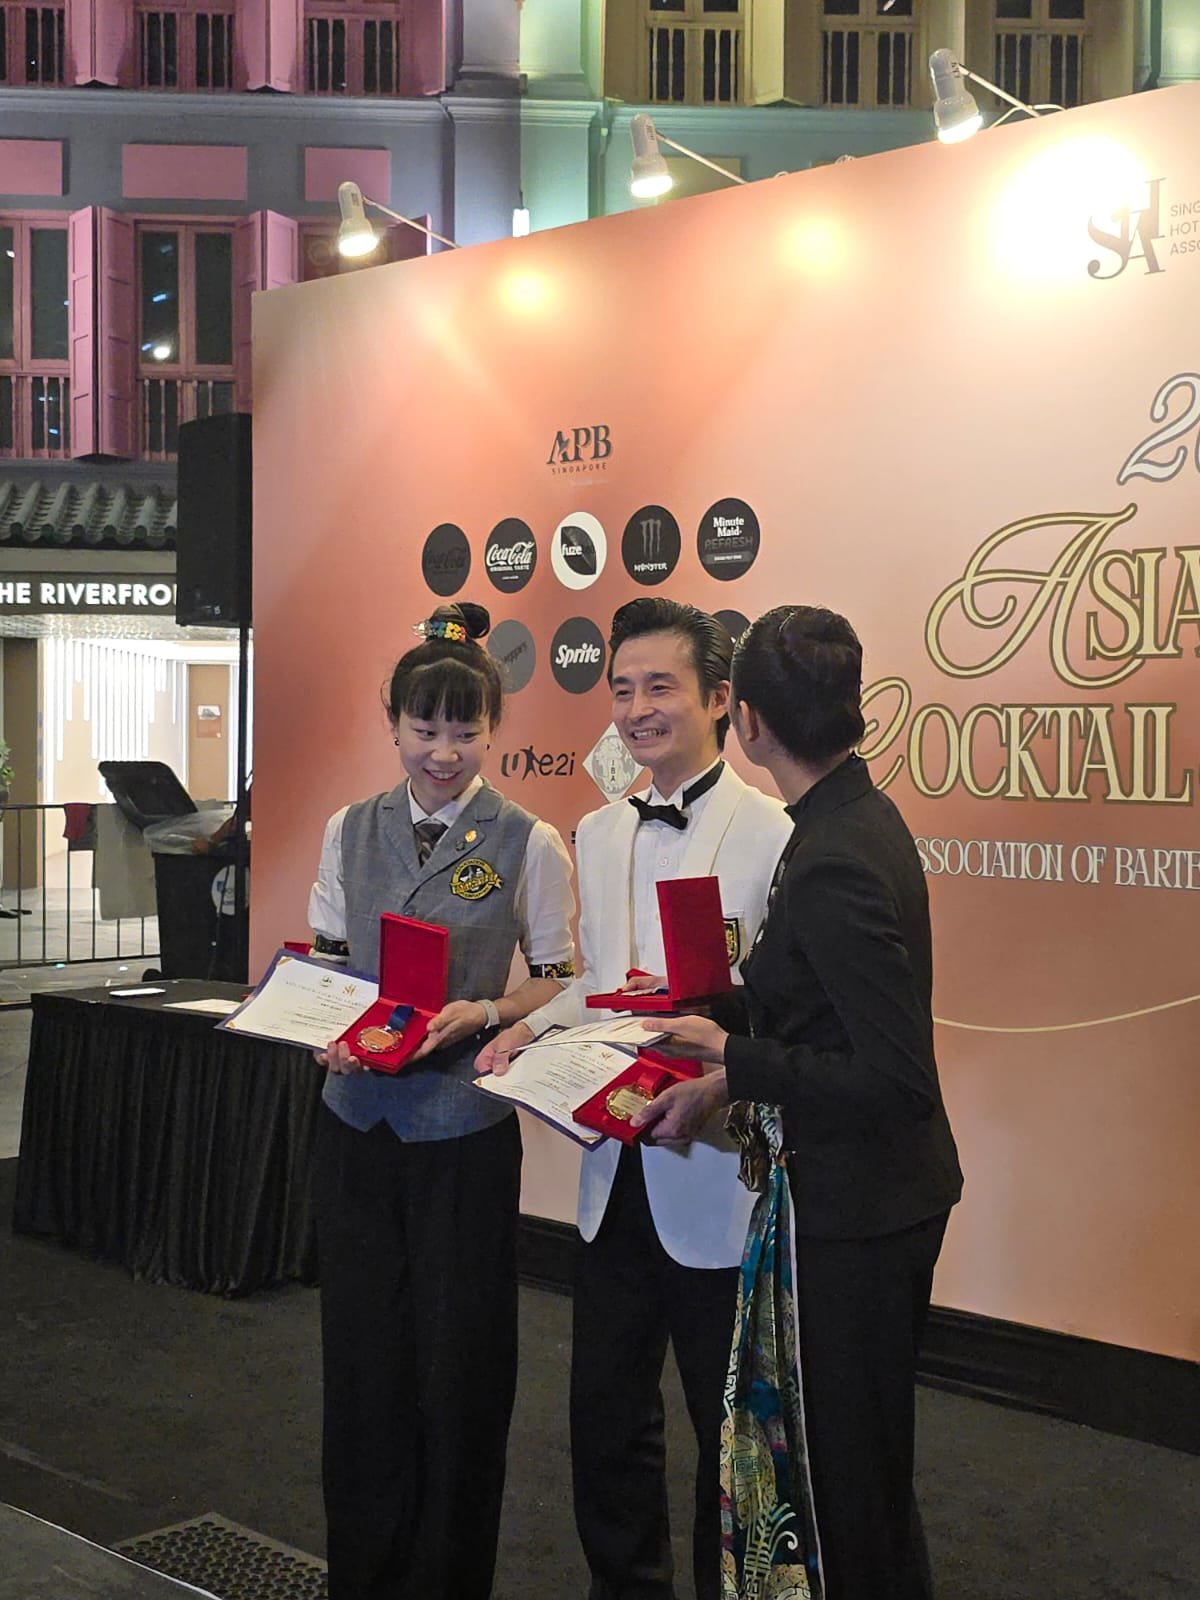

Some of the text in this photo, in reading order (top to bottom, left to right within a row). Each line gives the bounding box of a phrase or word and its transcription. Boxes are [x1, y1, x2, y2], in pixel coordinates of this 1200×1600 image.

[1169, 220, 1199, 237] HOT
[1116, 372, 1200, 486] 2
[546, 425, 612, 464] APB
[551, 462, 608, 475] SINGAPORE
[713, 516, 745, 528] Minute
[561, 543, 583, 556] fuze
[704, 536, 754, 550] REFRESH
[40, 582, 177, 605] RIVERFRO
[555, 642, 601, 669] Sprite
[1070, 844, 1107, 885] OF
